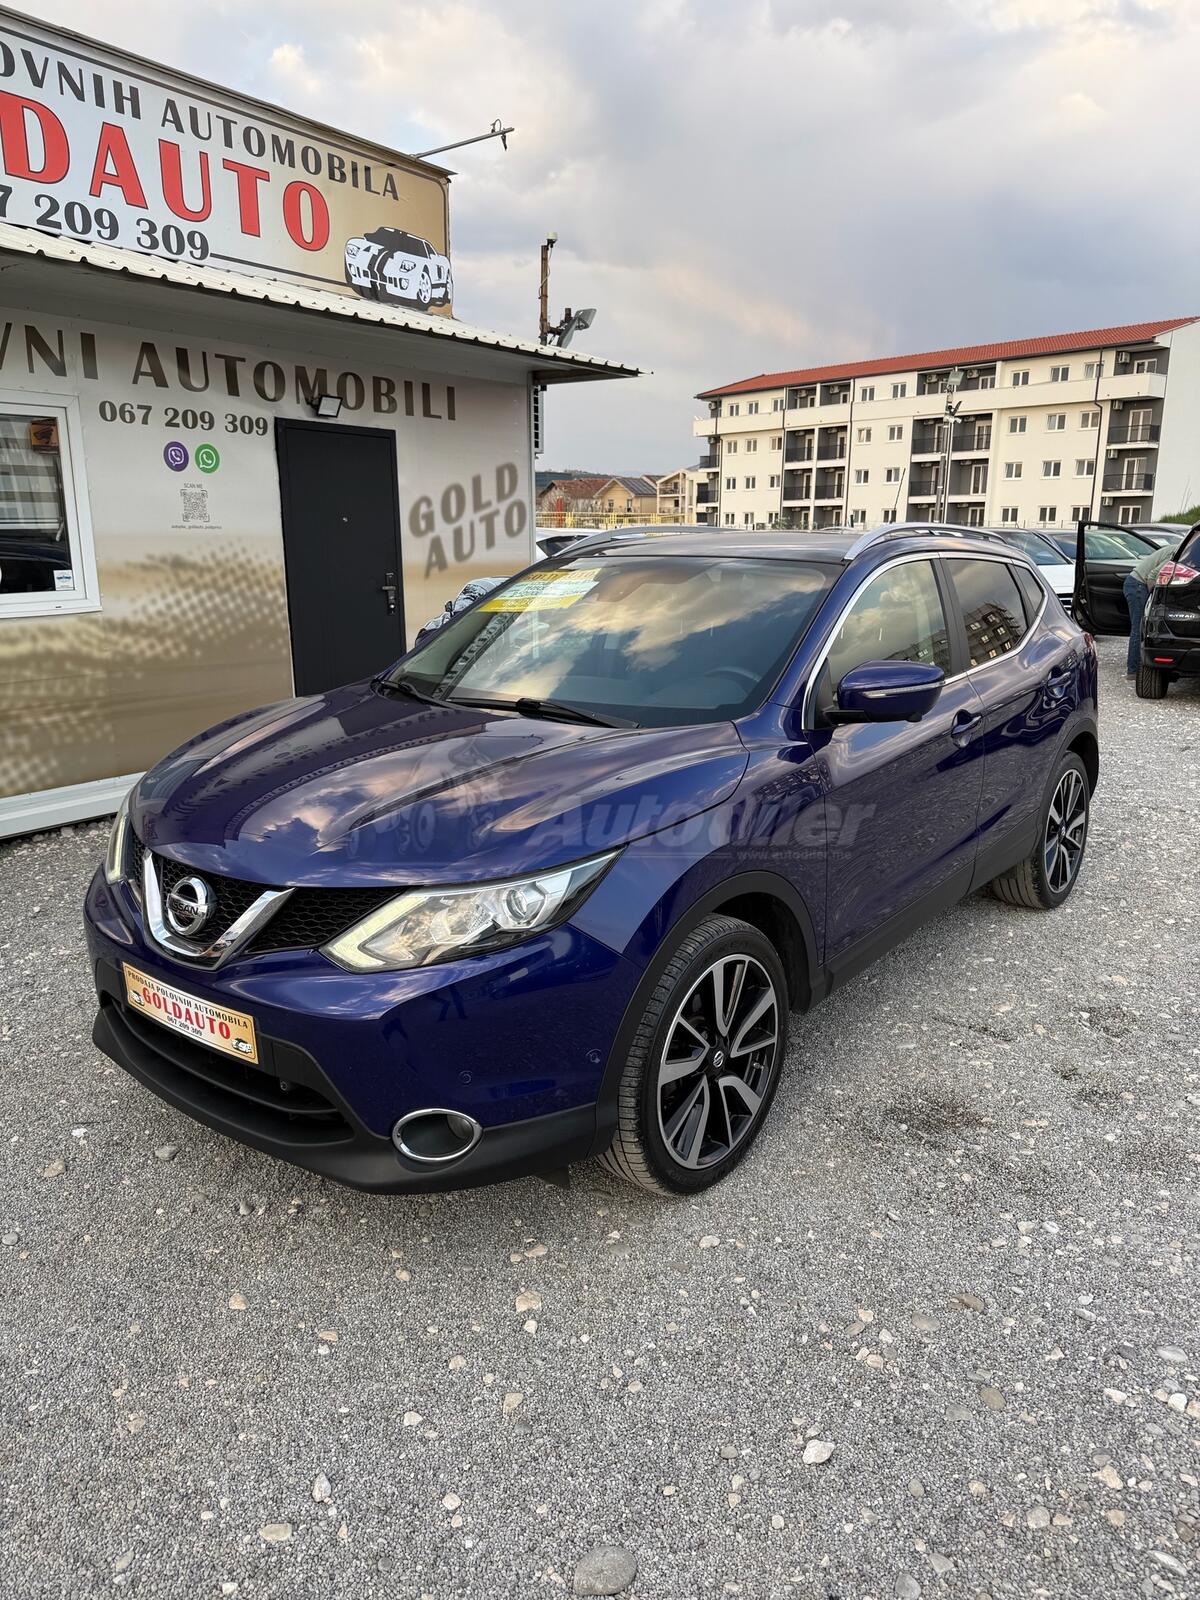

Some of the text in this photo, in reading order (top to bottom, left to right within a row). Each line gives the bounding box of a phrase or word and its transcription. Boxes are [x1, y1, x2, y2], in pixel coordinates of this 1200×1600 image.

[0, 90, 330, 252] DAUTO
[160, 98, 399, 201] AUTOMOBILA
[34, 193, 120, 241] 209
[136, 217, 209, 261] 309
[132, 341, 456, 421] AUTOMOBILI
[98, 400, 268, 436] 067 209 309
[408, 462, 519, 538] GOLD
[424, 499, 527, 579] AUTO
[127, 969, 248, 1029] PRODAJA POLOVNIH AUTOMOBILA
[142, 987, 231, 1040] GOLDAUTO
[167, 1015, 177, 1025] 067
[178, 1020, 190, 1031] 209
